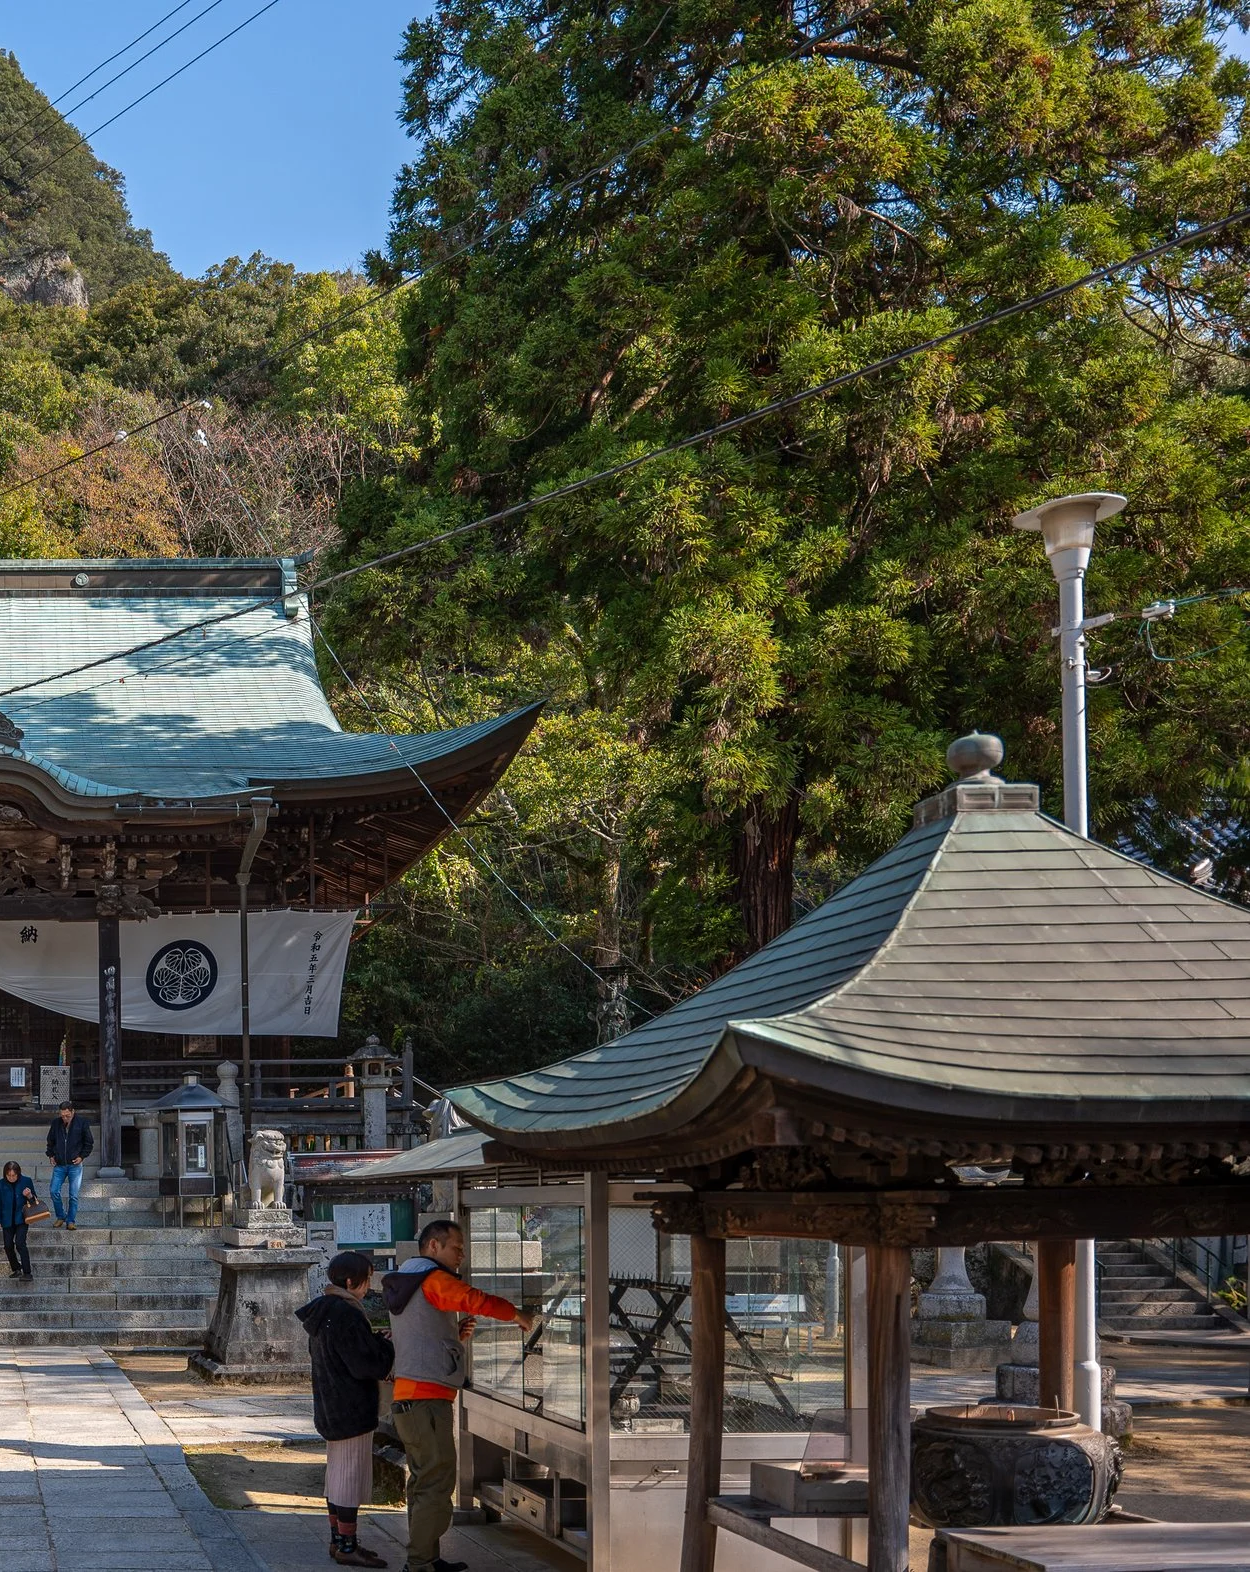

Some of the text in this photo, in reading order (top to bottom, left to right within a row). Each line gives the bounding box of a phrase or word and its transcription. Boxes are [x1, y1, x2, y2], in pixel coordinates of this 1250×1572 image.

[19, 925, 39, 944] 納
[304, 931, 323, 1015] 令和五年三月吉日
